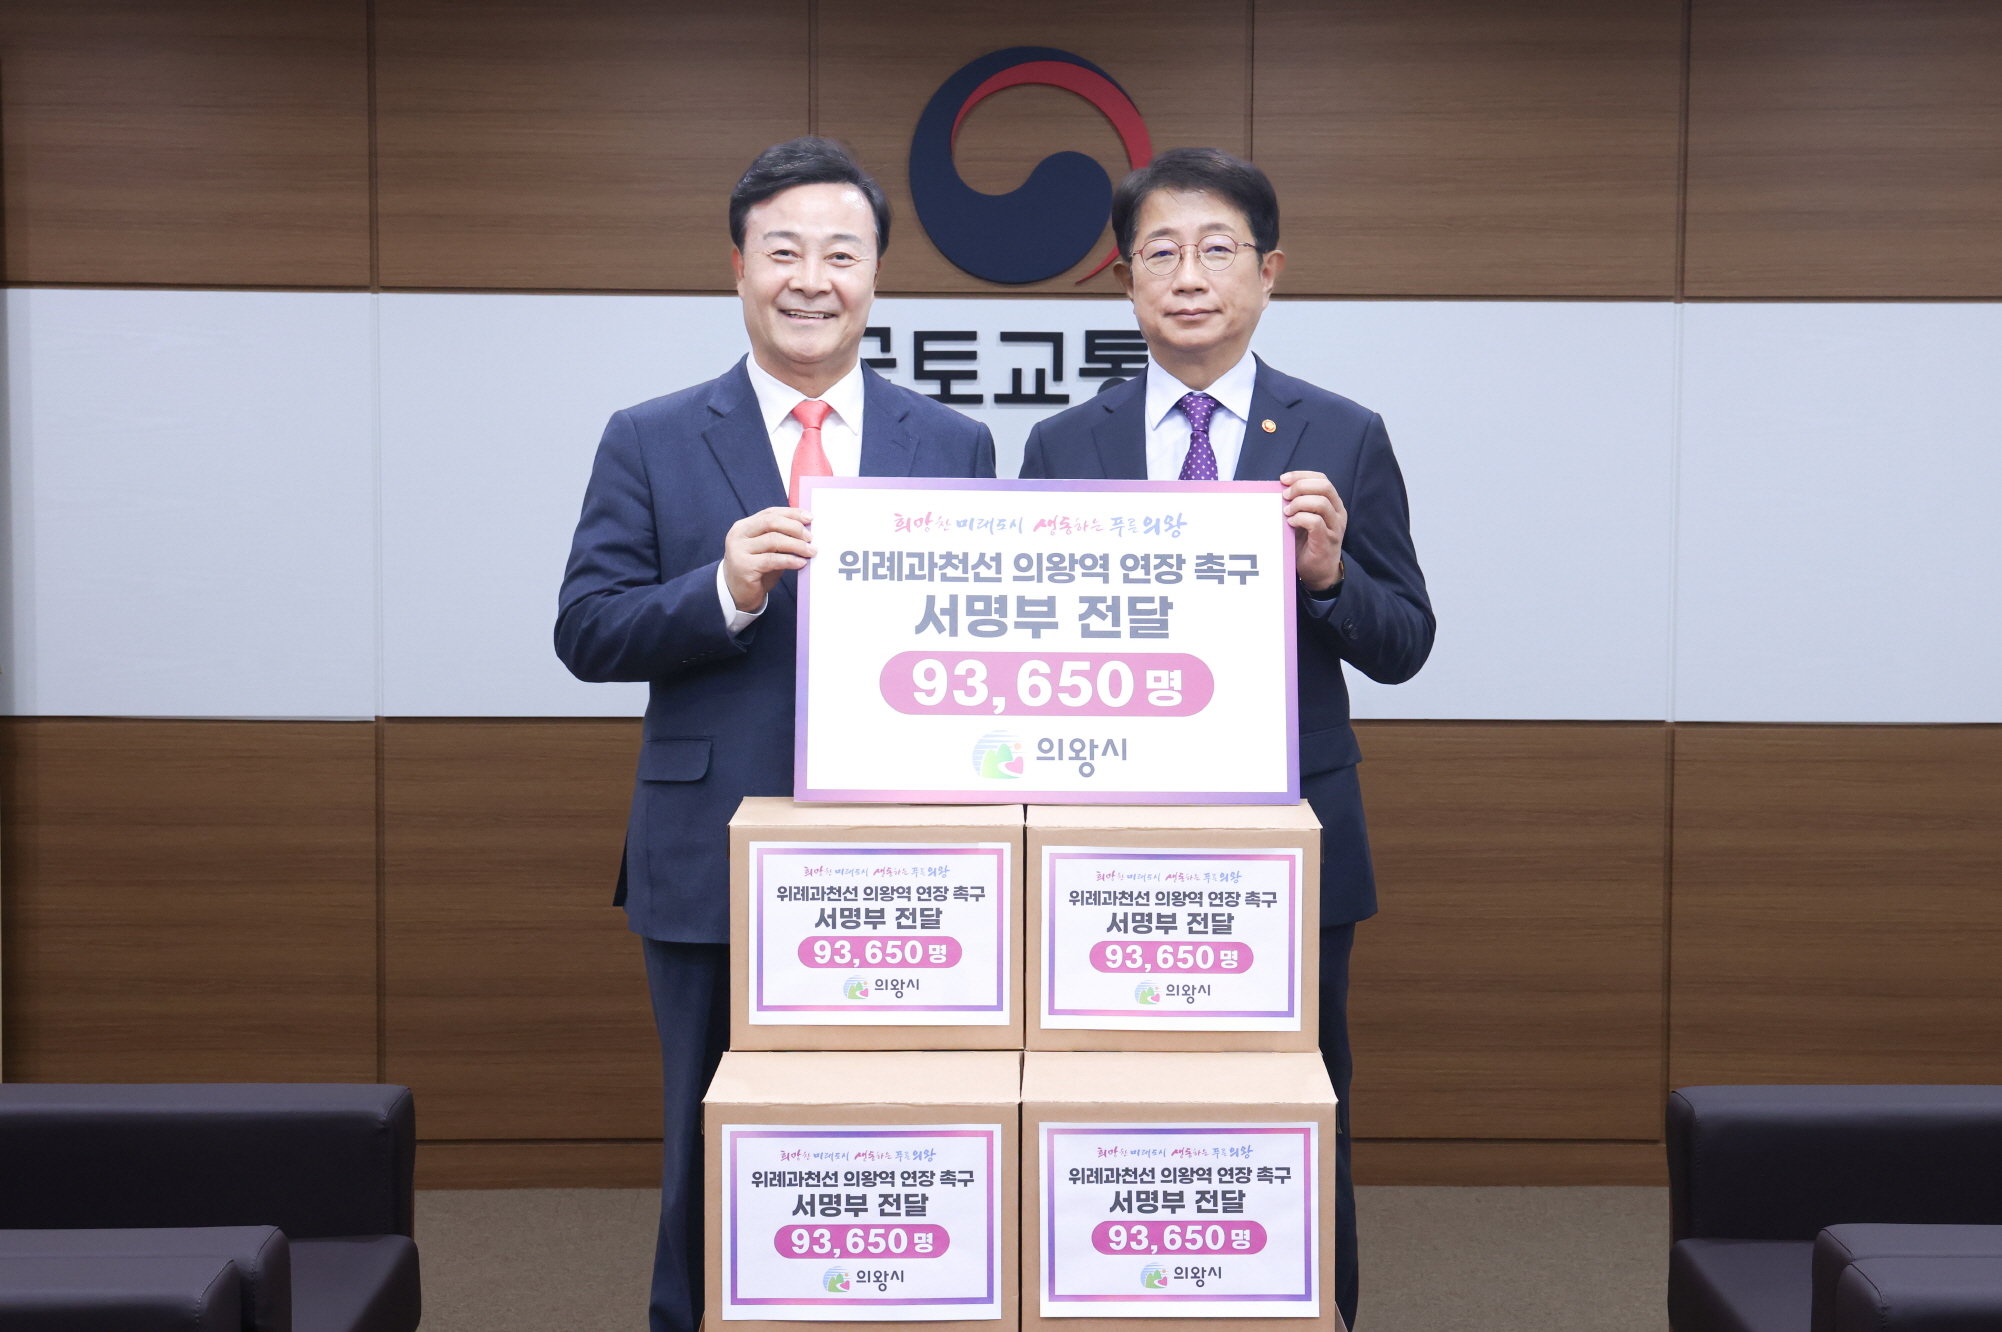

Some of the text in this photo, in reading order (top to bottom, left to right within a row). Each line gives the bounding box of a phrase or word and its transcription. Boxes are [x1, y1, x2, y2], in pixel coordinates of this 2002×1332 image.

[838, 551, 1259, 585] 위례과천선 의왕역 연장 촉구
[915, 594, 1173, 639] 서명부 전달
[911, 658, 1182, 715] 93,650 명
[1036, 738, 1126, 778] 의왕시
[777, 886, 985, 902] 위례과천선 의왕역 연장 촉구
[1069, 890, 1277, 908] 위례과천선 의왕역 연장 촉구
[815, 908, 942, 930] 서명부 전달
[1107, 912, 1234, 935] 서명부 전달
[813, 940, 947, 967] 93,650 명
[1105, 945, 1238, 972] 93,650 명
[875, 979, 919, 998] 의왕시
[1166, 984, 1210, 1004] 의왕시
[752, 1170, 974, 1187] 위례과천선 의왕역 연장 촉구
[1069, 1166, 1291, 1184] 위례과천선 의왕역 연장 촉구
[792, 1193, 929, 1217] 서명부 전달
[1110, 1190, 1246, 1214] 서명부 전달
[791, 1228, 933, 1258] 93,650 명
[1108, 1225, 1251, 1254] 93,650 명
[856, 1270, 904, 1292] 의왕시
[1174, 1267, 1221, 1287] 의왕시
